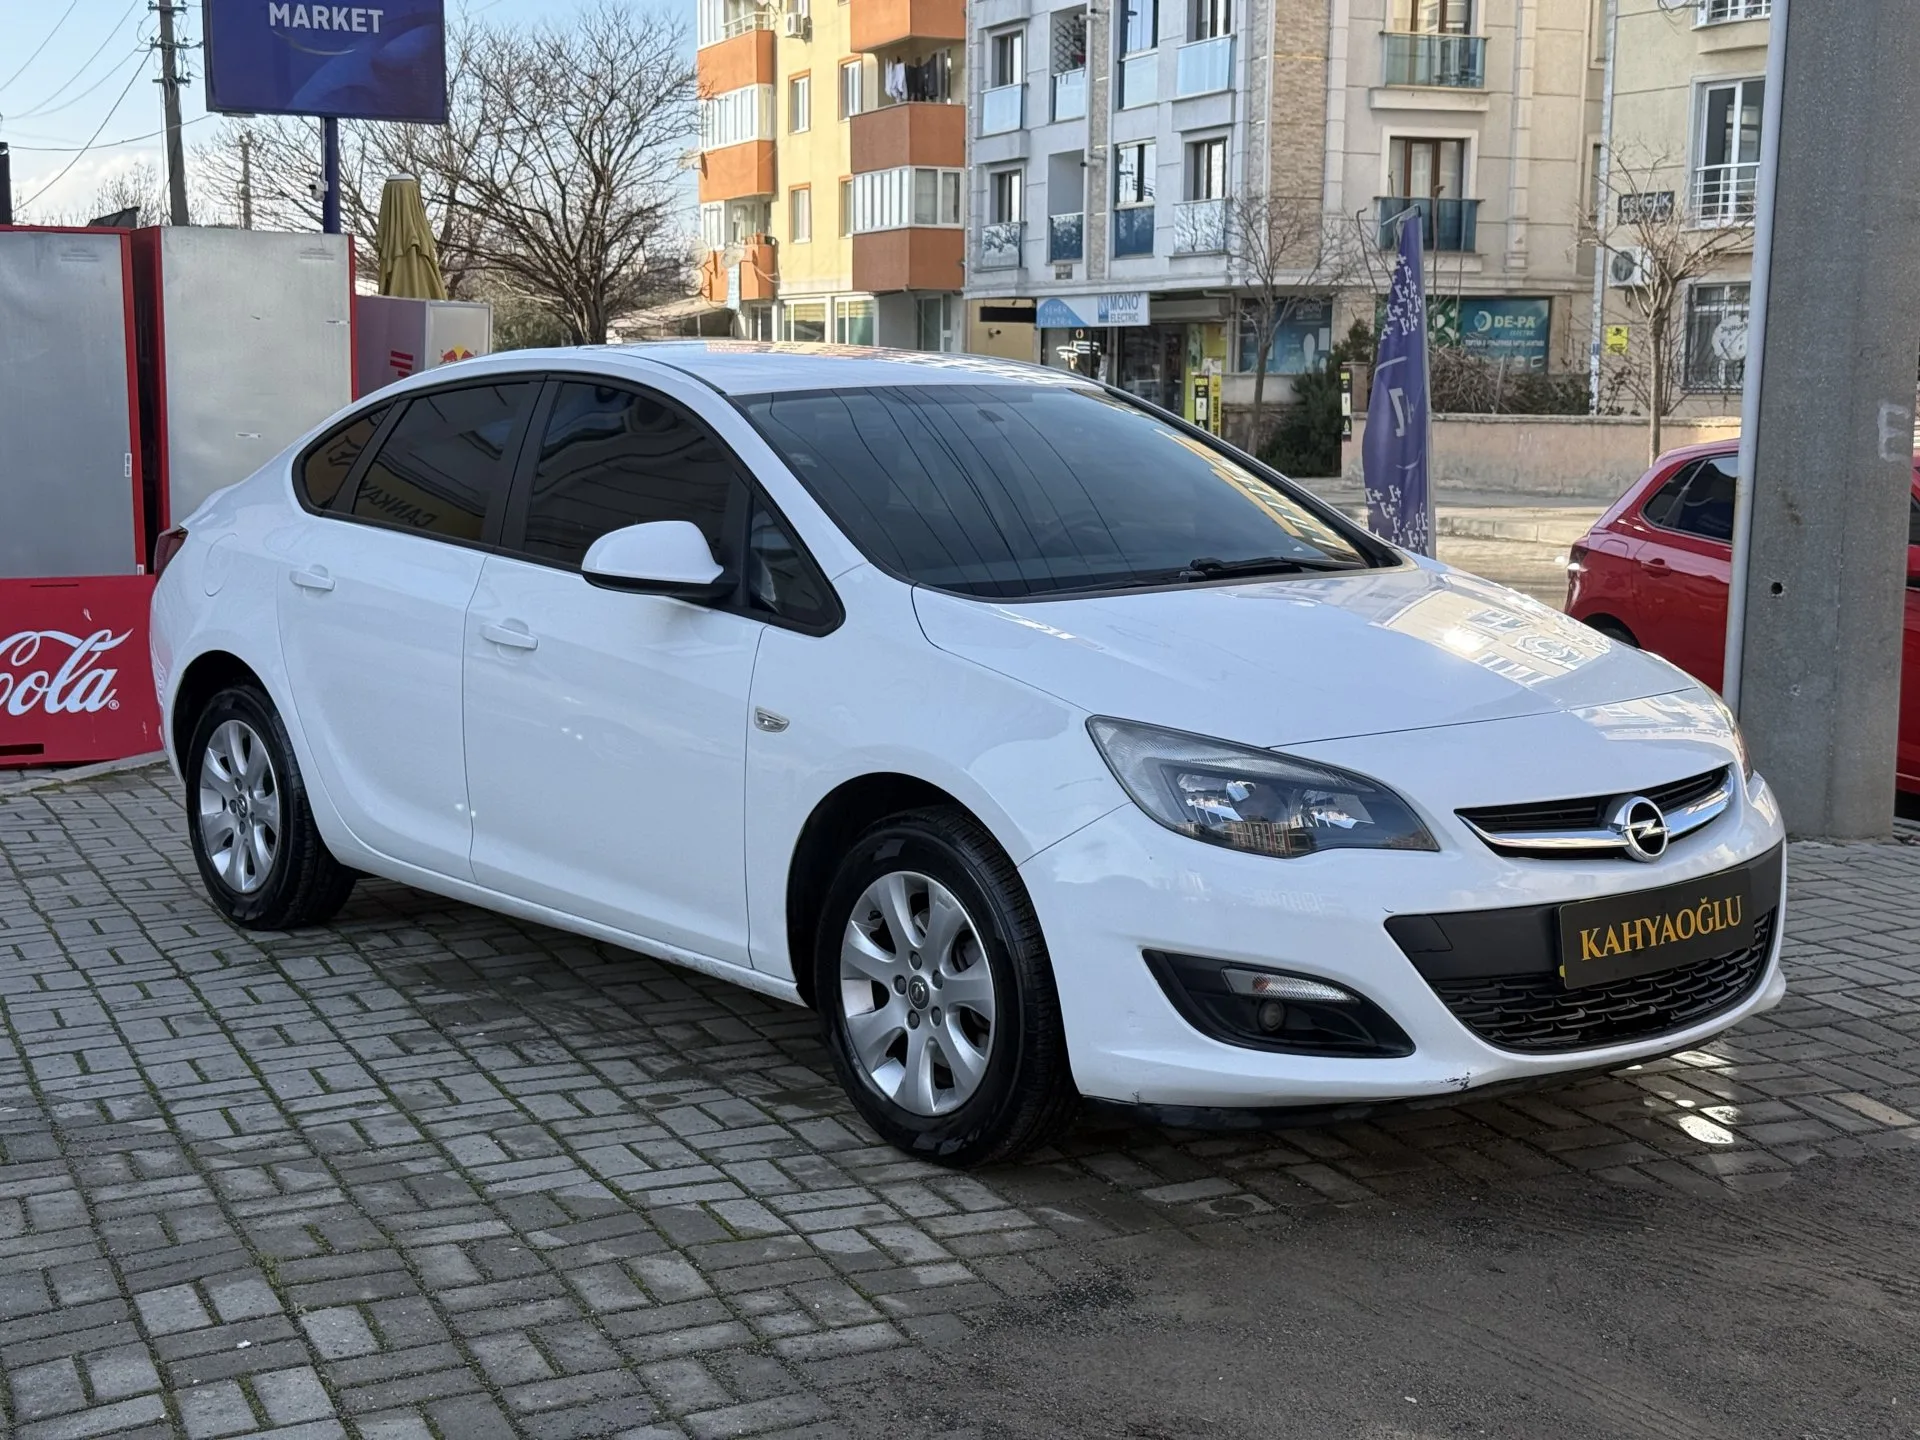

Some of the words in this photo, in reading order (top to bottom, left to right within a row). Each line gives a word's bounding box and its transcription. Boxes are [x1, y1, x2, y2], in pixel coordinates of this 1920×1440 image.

[269, 2, 384, 33] MARKET
[1110, 294, 1139, 311] MONO
[1110, 313, 1139, 323] ELECTRIC
[1580, 895, 1742, 961] KAHYAOĞLU
